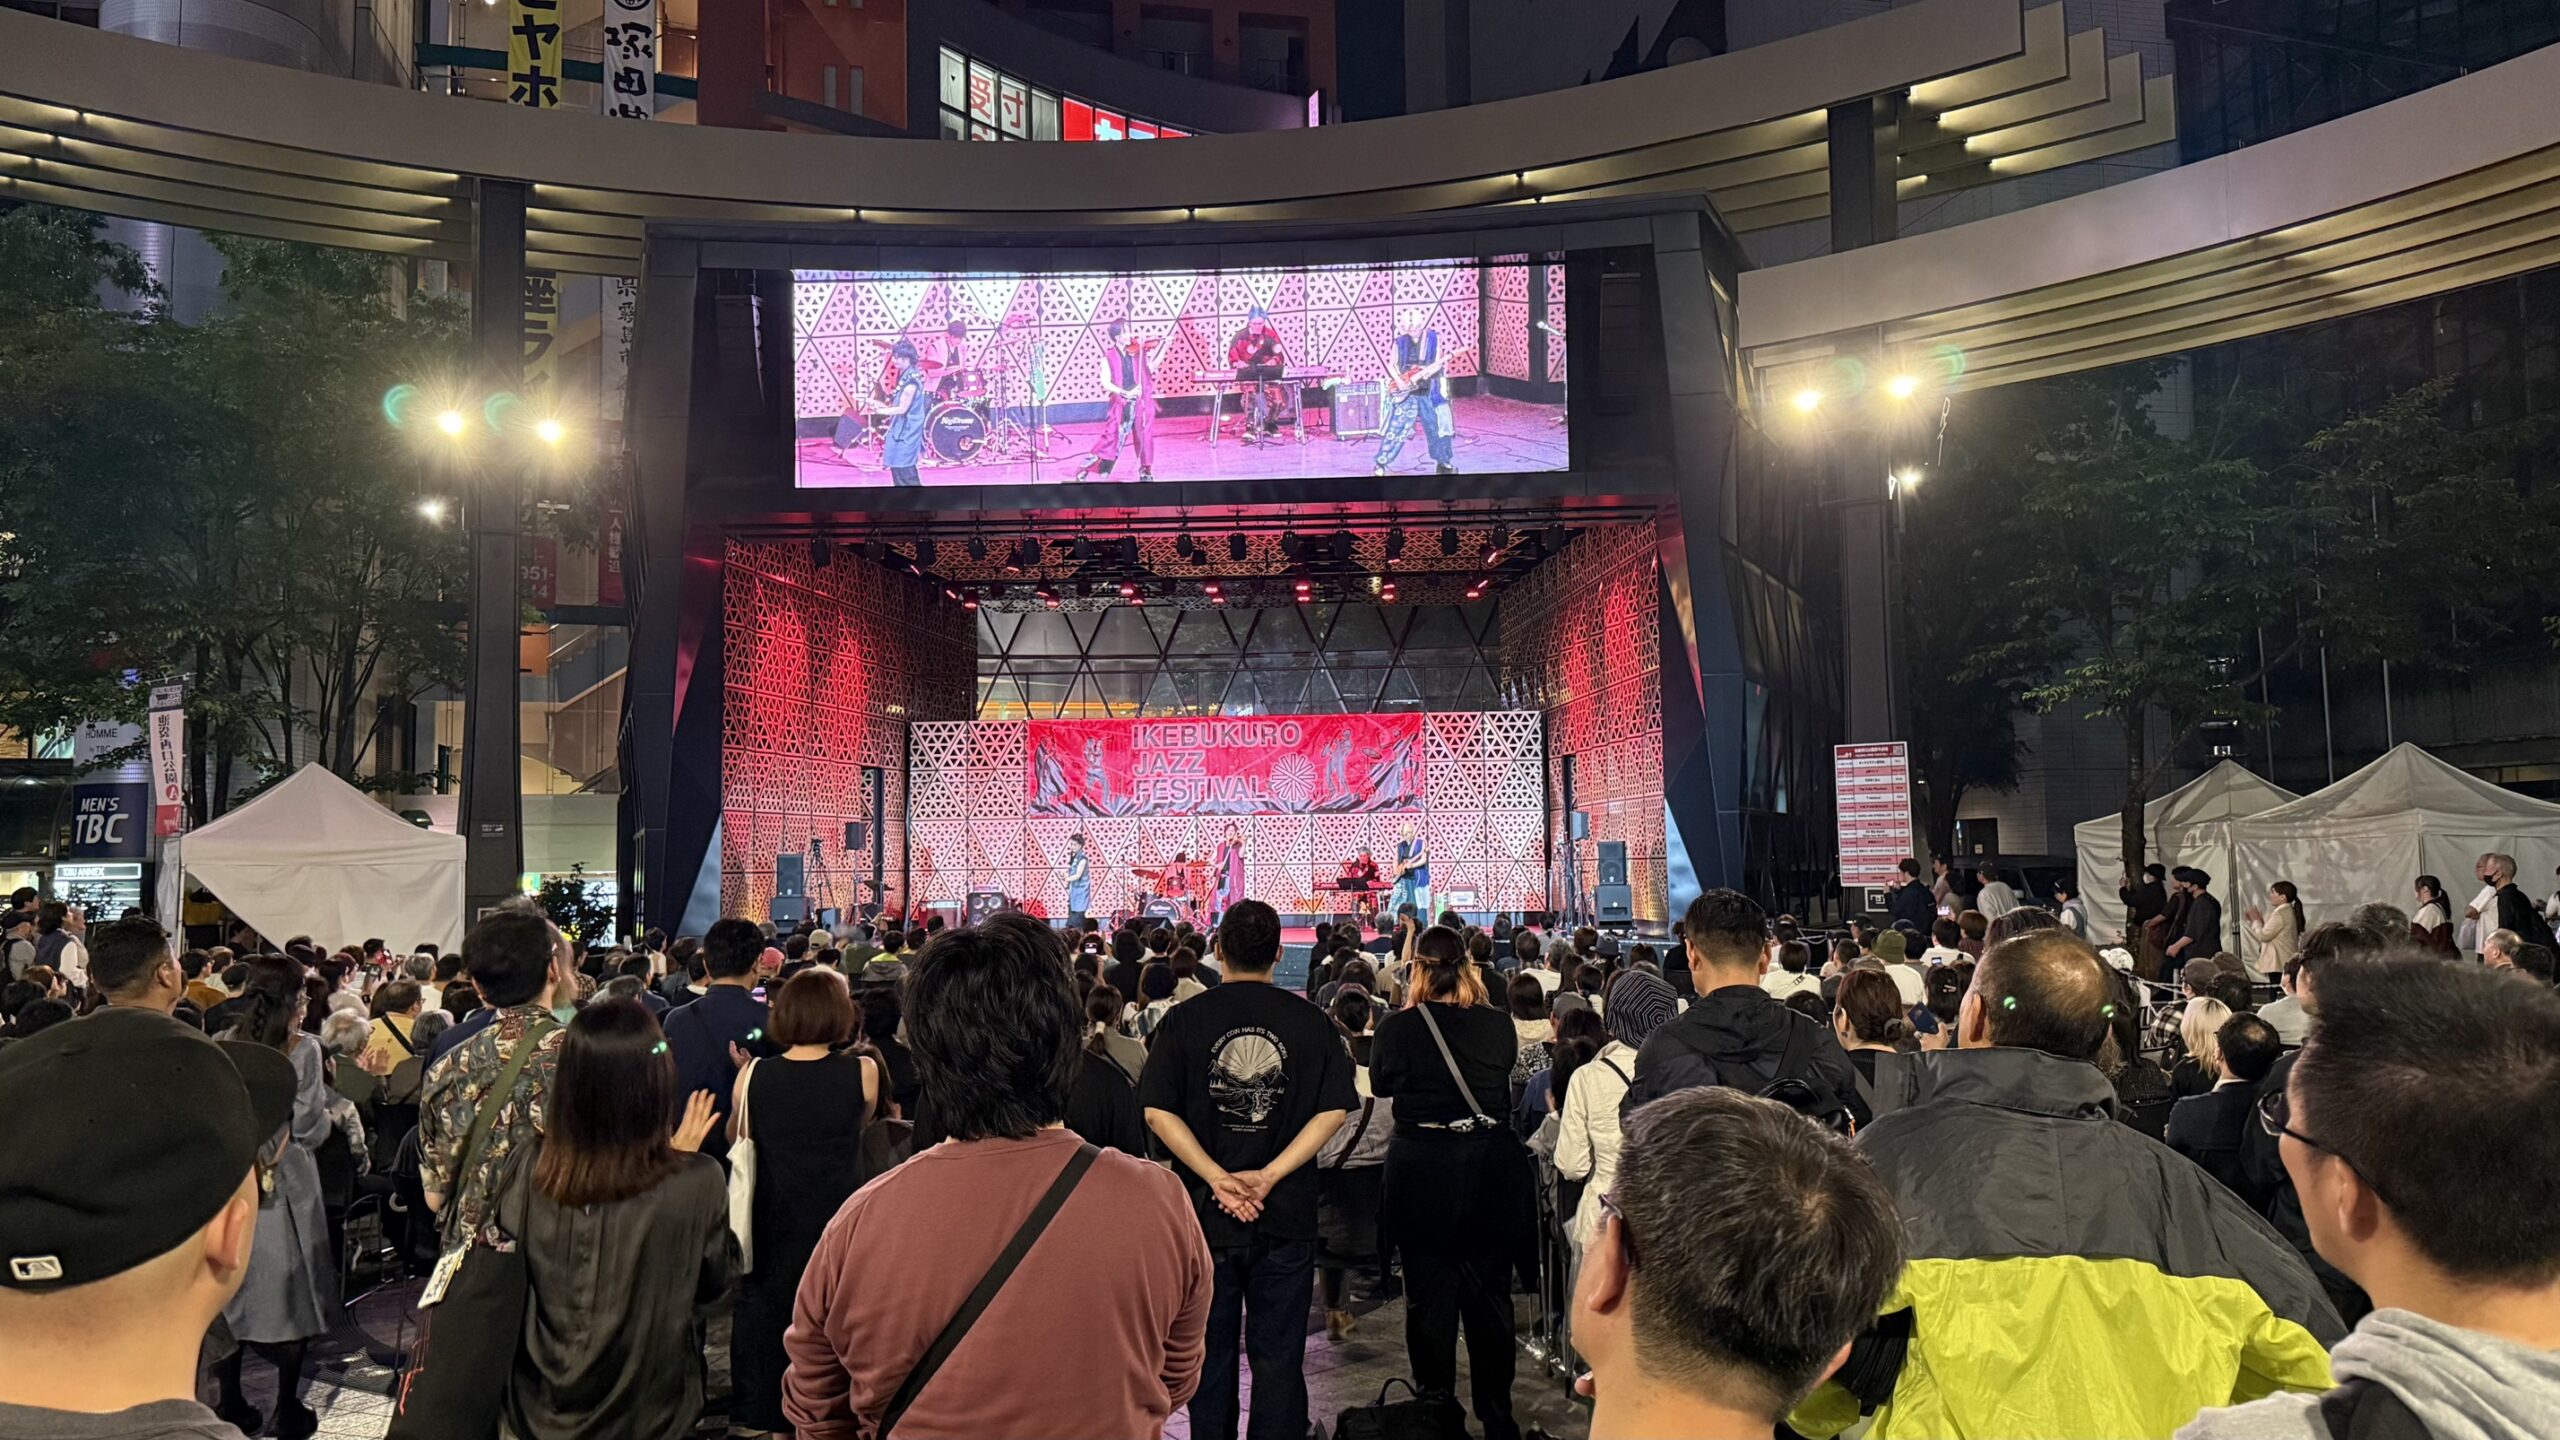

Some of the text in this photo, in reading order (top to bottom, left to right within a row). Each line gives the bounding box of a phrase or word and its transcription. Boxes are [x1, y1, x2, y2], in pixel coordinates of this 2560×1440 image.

[85, 728, 118, 739] HOMME
[1132, 721, 1301, 749] IKEBUKURO
[96, 745, 111, 753] TBC
[1133, 750, 1206, 776] JAZZ
[1134, 776, 1269, 802] FESTIVAL
[81, 797, 120, 812] MEN'S
[76, 813, 129, 844] TBC
[1210, 1035, 1226, 1053] EVERY
[1226, 1028, 1240, 1037] COIN
[1267, 1031, 1279, 1042] TWO
